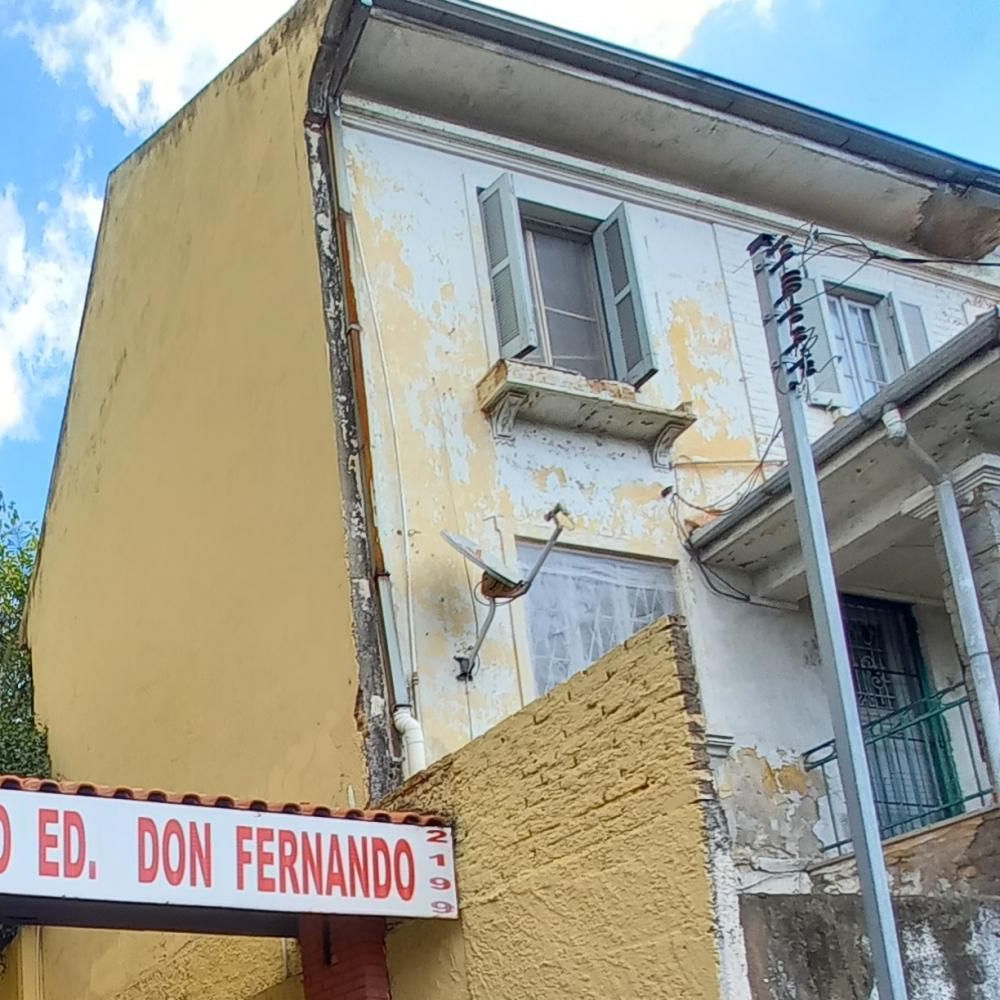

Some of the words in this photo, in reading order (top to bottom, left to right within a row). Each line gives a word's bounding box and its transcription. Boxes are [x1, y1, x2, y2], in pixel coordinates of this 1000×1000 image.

[38, 808, 97, 880] ED.
[137, 816, 213, 888] DON
[235, 825, 416, 901] FERNANDO
[425, 829, 454, 914] 2199
